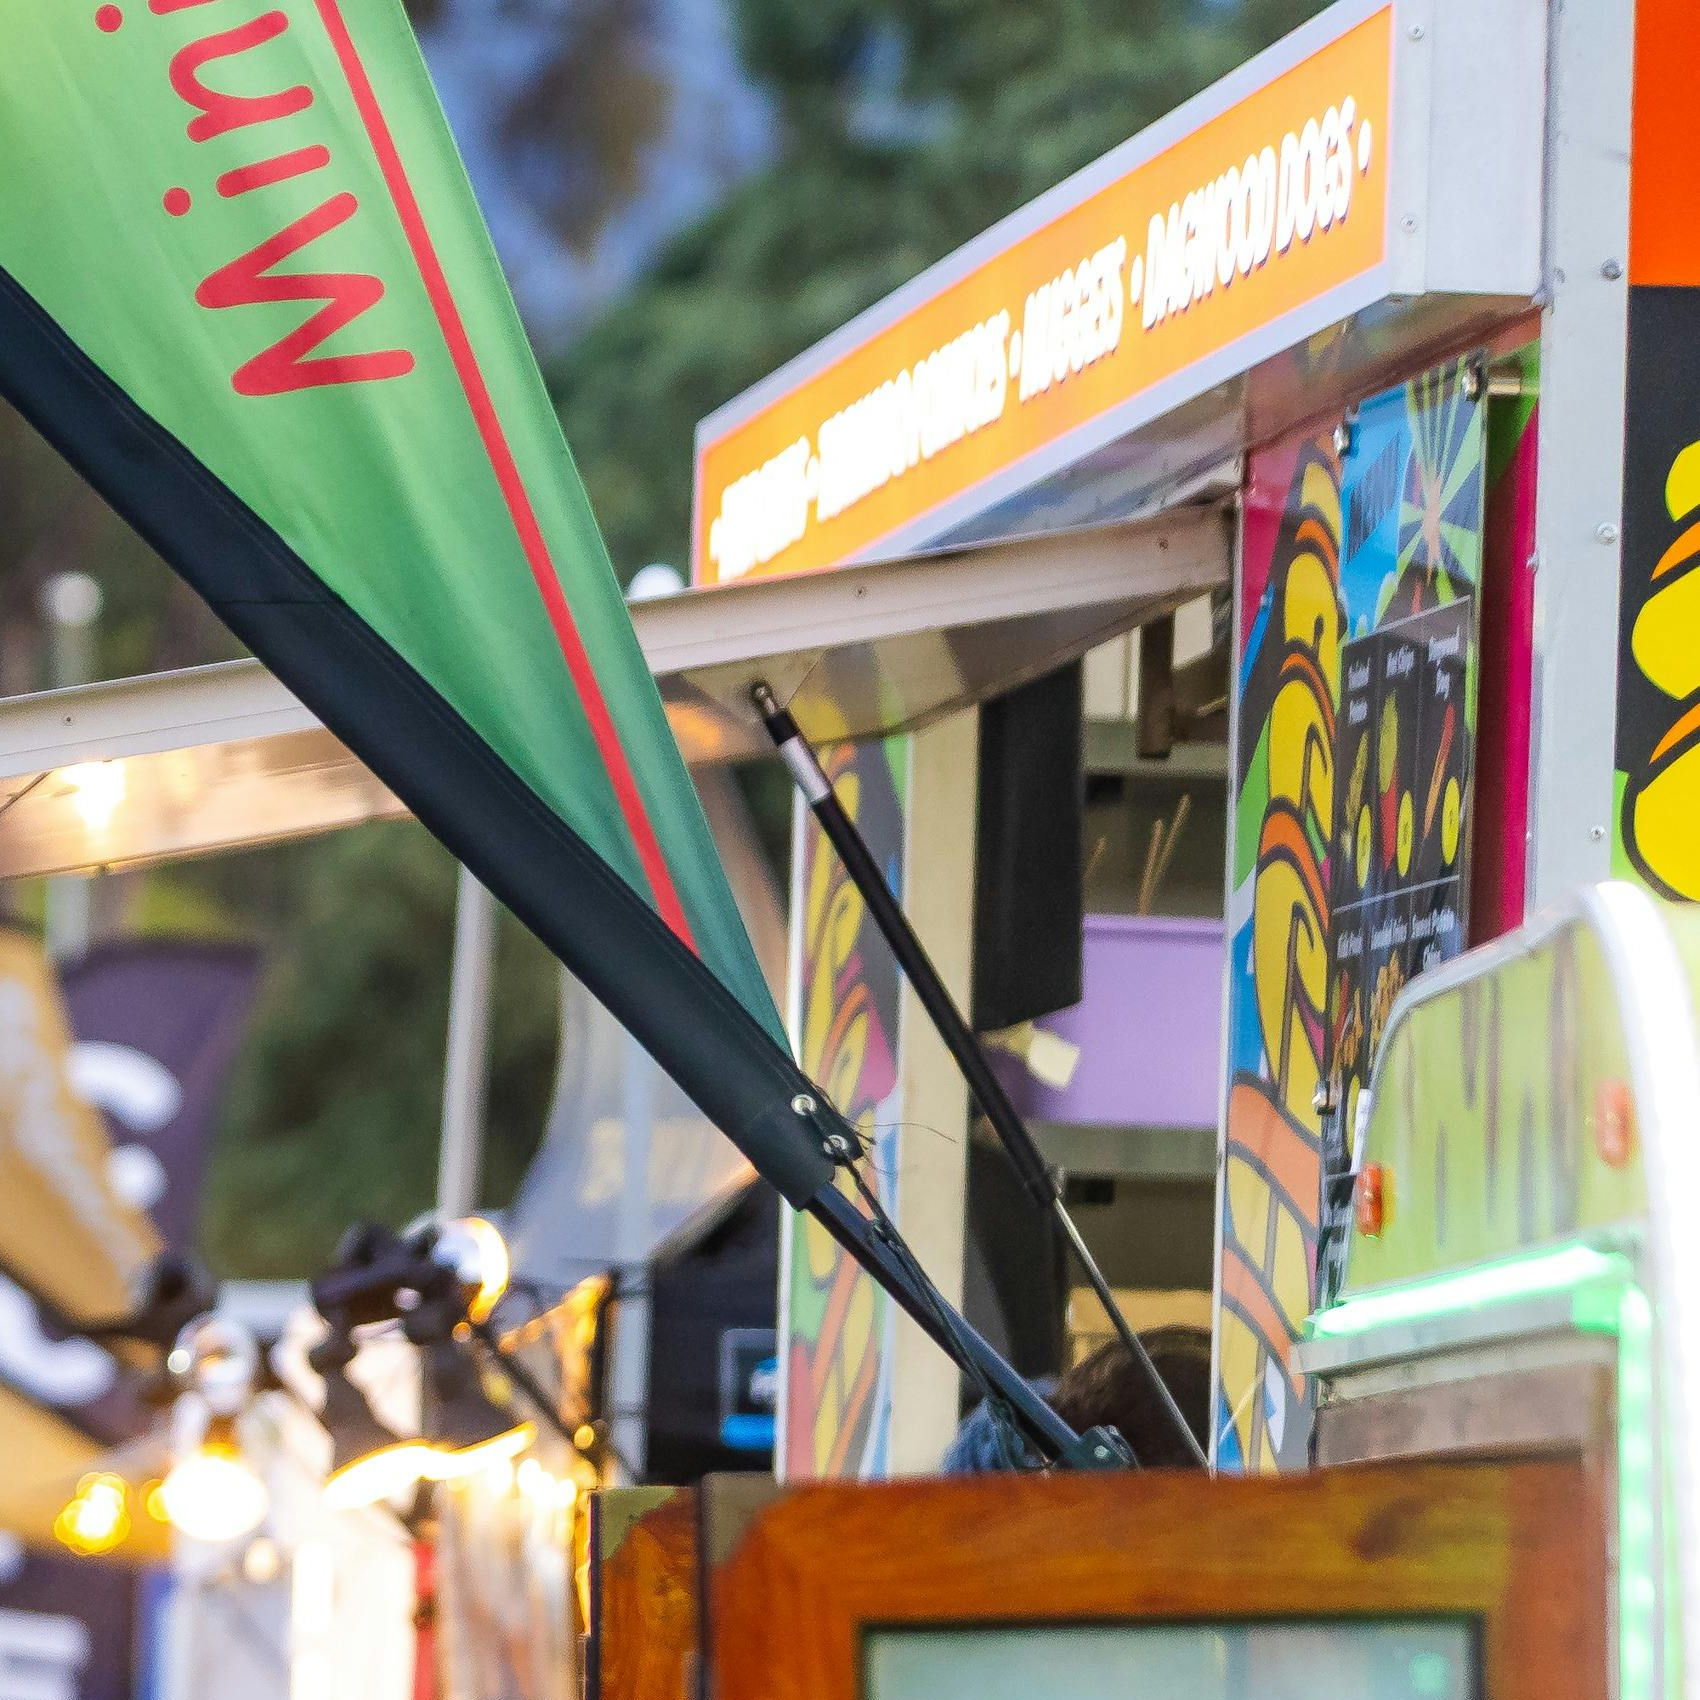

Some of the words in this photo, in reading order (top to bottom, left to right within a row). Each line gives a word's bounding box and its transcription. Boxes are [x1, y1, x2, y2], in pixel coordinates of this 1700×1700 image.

[1019, 235, 1127, 405] NUGGETS
[1143, 145, 1278, 333] DAGWOOD
[1276, 94, 1357, 257] DOGS
